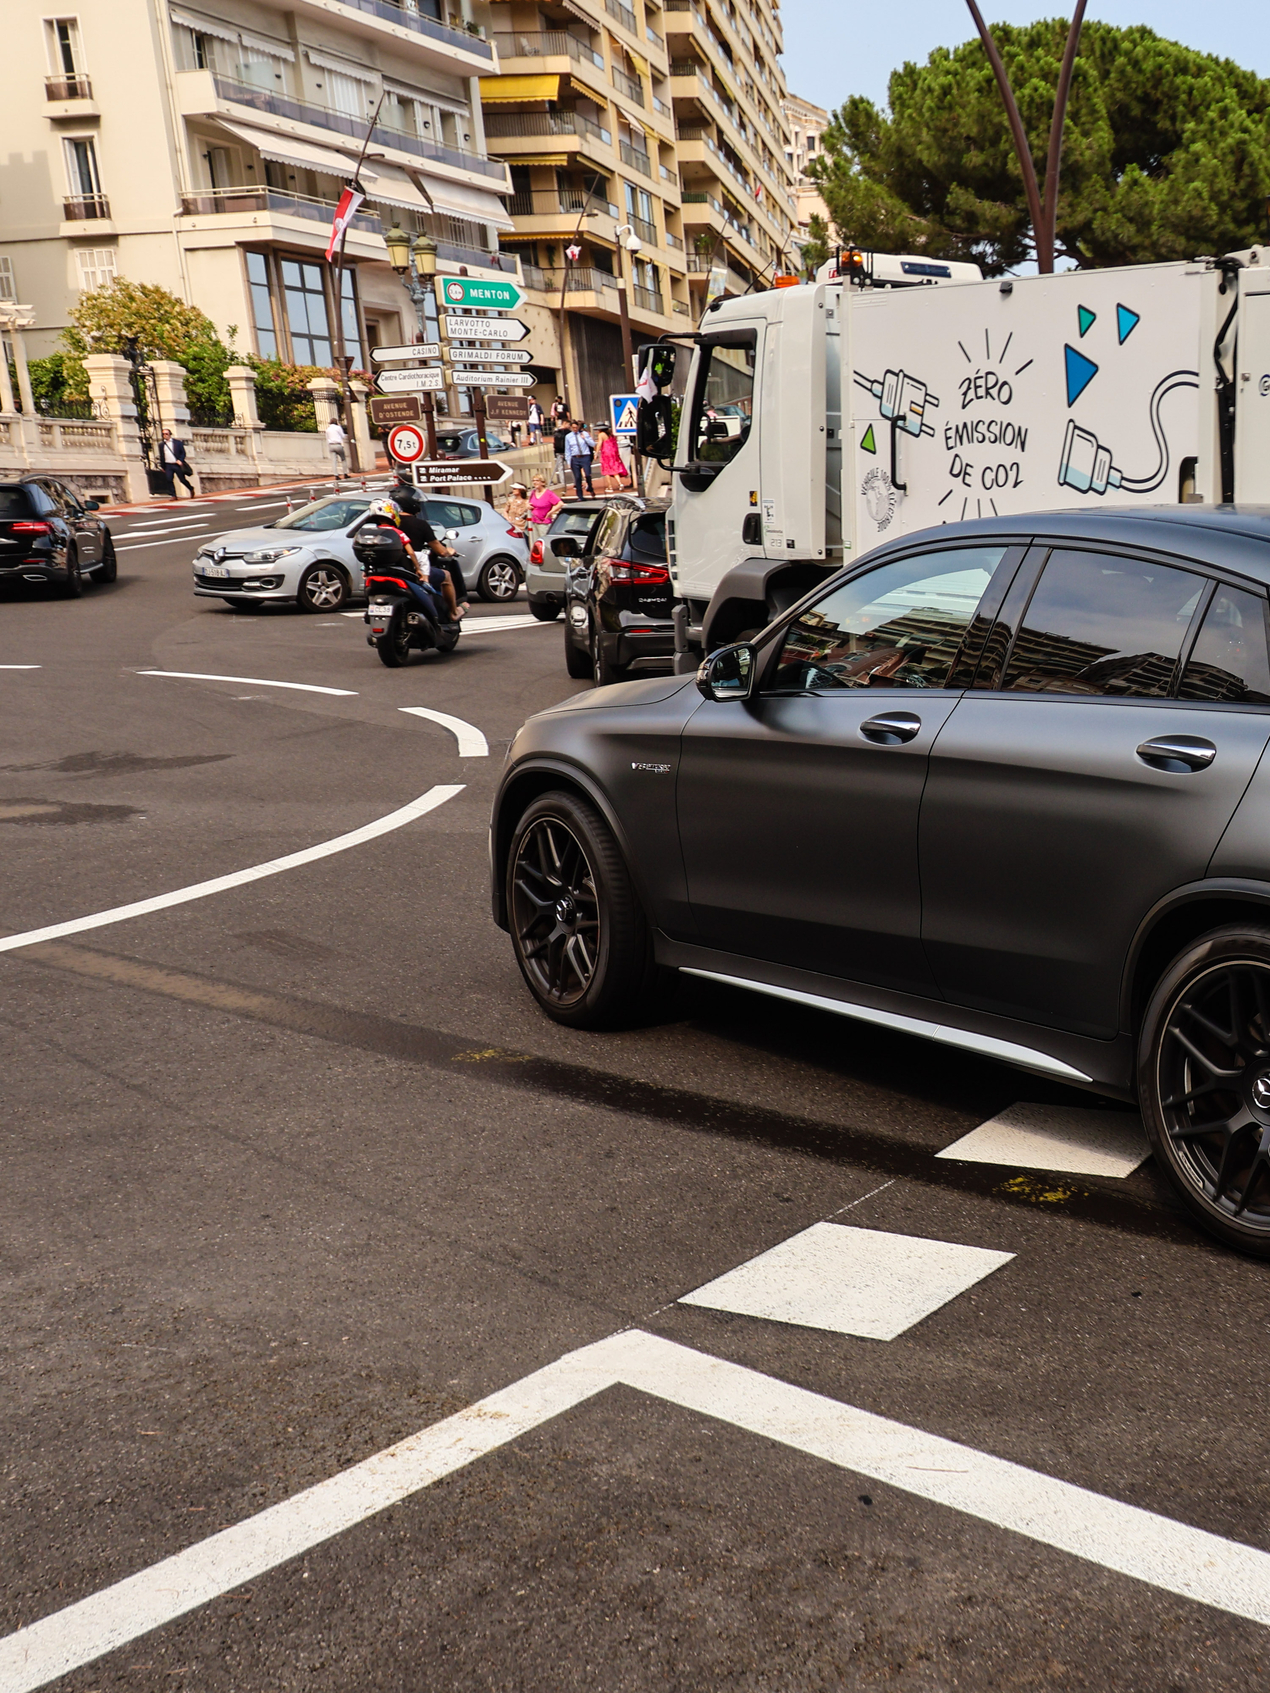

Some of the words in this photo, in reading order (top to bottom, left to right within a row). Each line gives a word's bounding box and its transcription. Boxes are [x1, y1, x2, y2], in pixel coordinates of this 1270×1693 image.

[470, 288, 510, 300] MENTON
[449, 318, 490, 328] LARVOTTO
[450, 327, 508, 337] MONTE-CARLO
[412, 346, 437, 356] CASINO
[452, 350, 492, 359] GRIMALDI
[496, 352, 524, 360] FORUM
[398, 372, 439, 380] Cardiothoracique
[456, 374, 493, 382] Auditorium
[495, 375, 518, 383] Rainier
[521, 376, 529, 384] III
[958, 368, 1013, 410] ZÉRO
[383, 402, 408, 410] AVENUE
[378, 410, 414, 419] D'OSTENDE
[944, 419, 1028, 453] ÉMISSION
[949, 453, 974, 488] DE
[981, 461, 1024, 490] CO2
